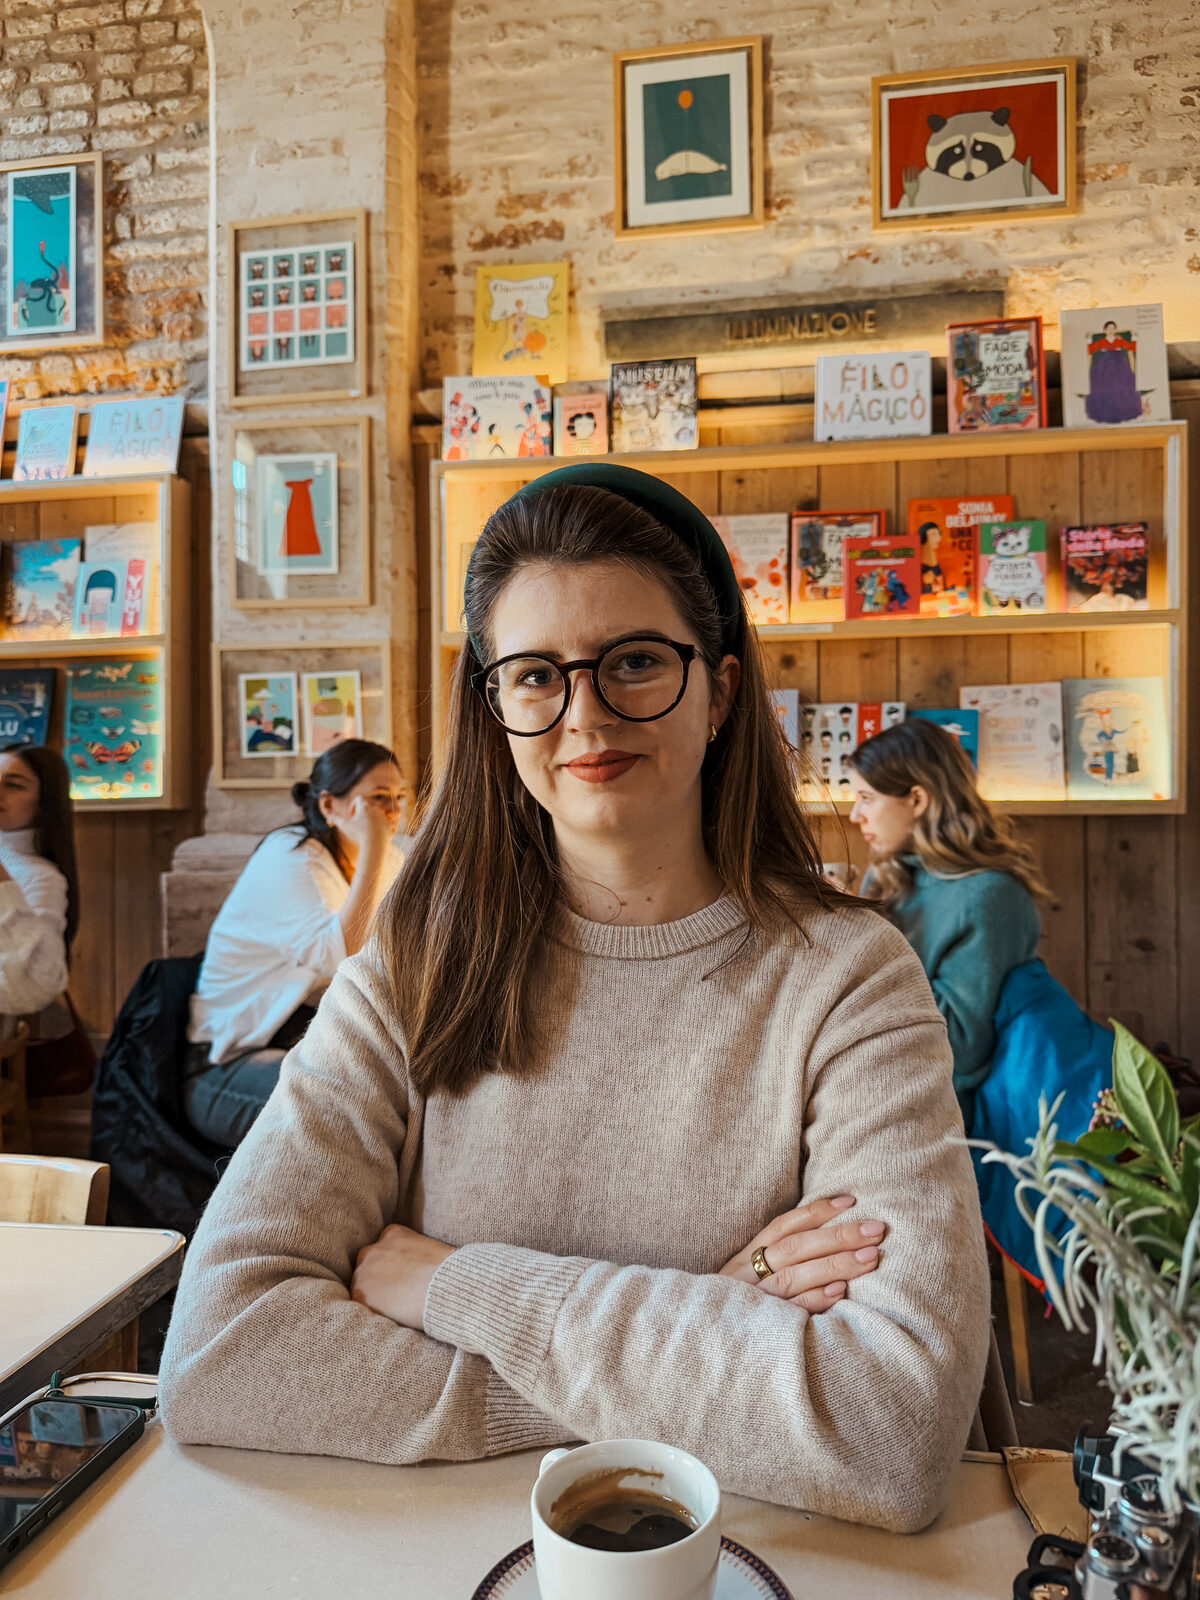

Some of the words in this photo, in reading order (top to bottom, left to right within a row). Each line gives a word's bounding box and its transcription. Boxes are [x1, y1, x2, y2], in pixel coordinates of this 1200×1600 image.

[841, 362, 908, 392] FILO
[110, 408, 163, 434] FILO
[823, 394, 926, 424] MAGICO
[93, 436, 174, 460] MAGICO
[958, 502, 994, 514] SONIA
[126, 573, 144, 627] YUMI
